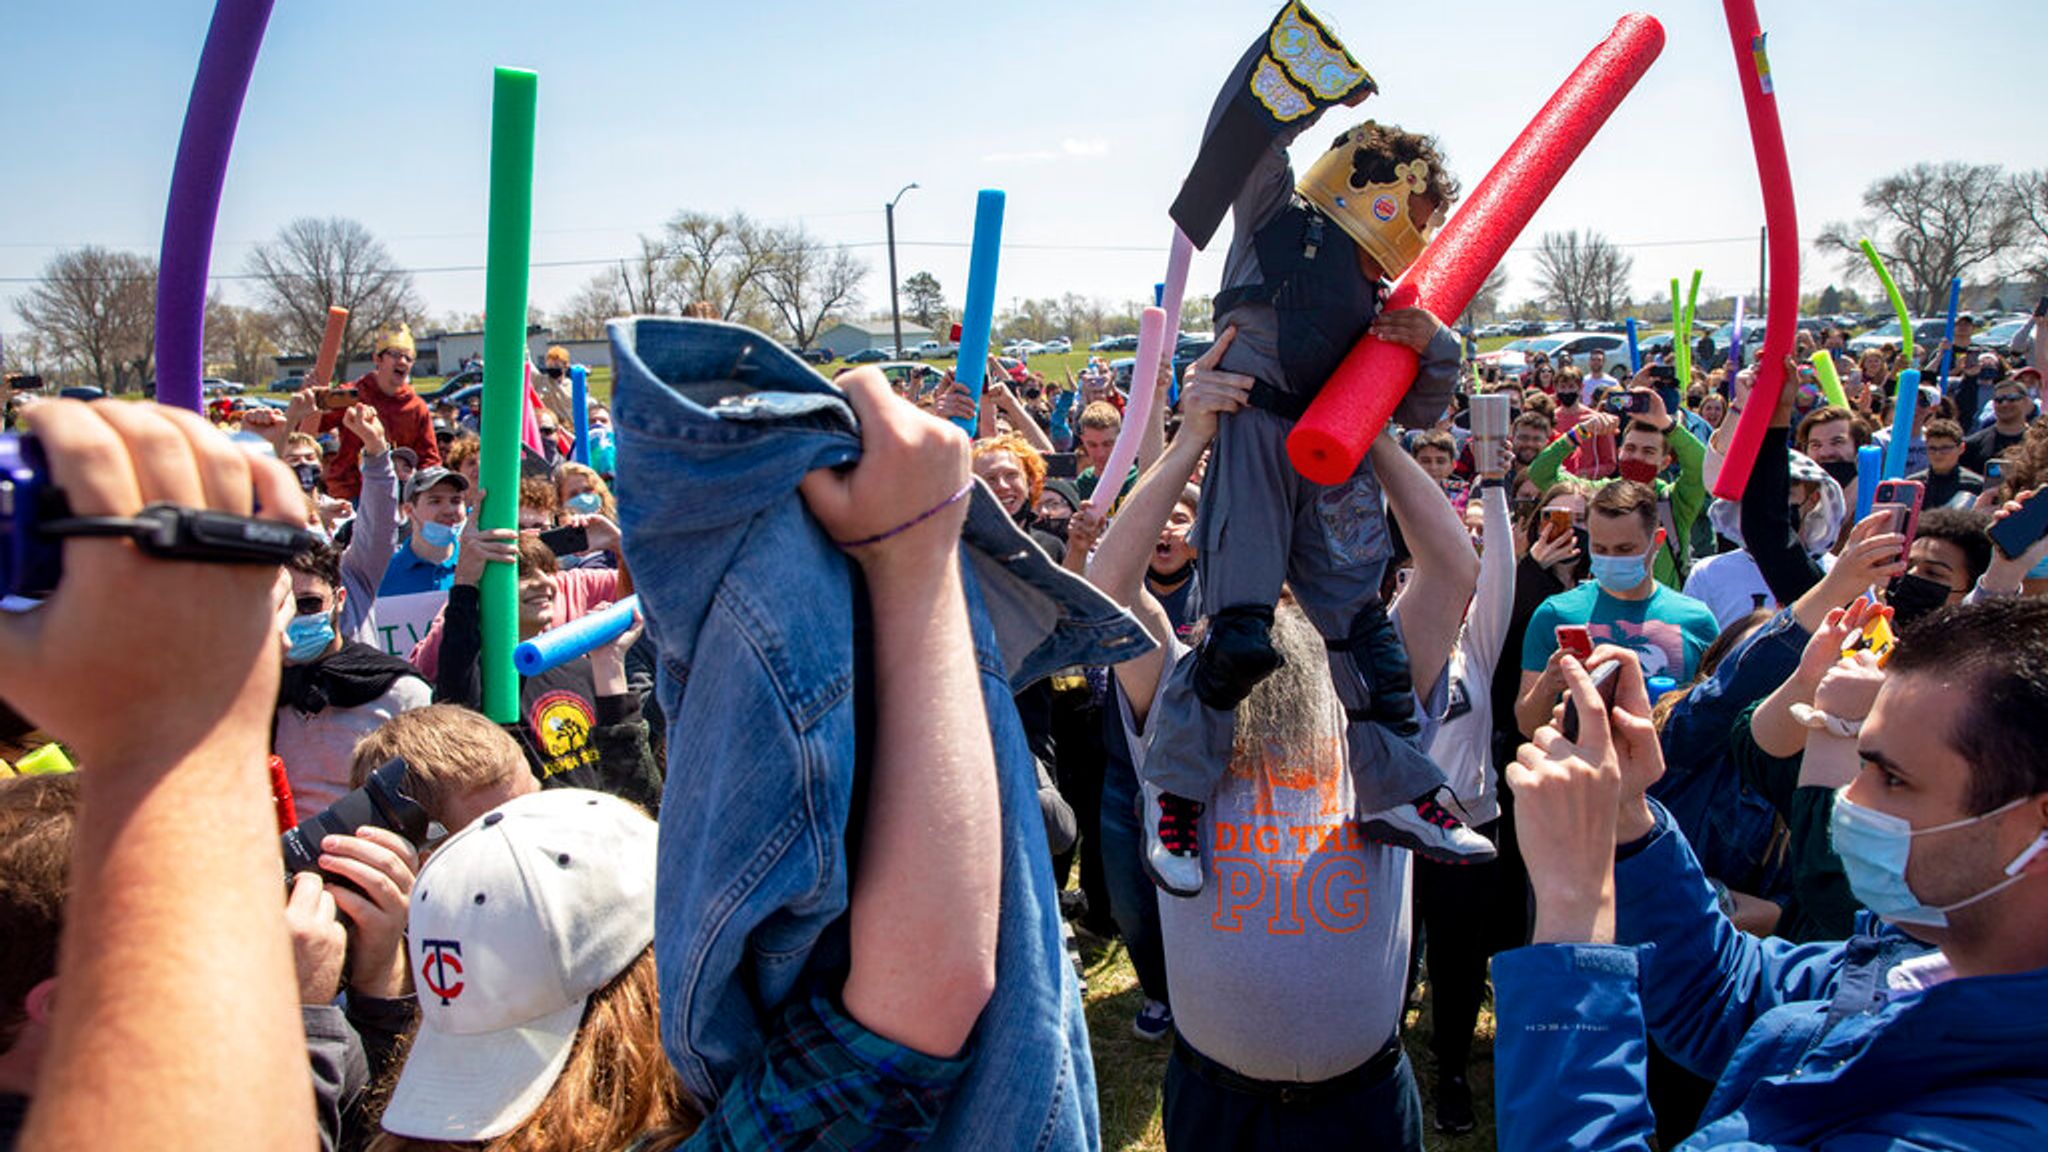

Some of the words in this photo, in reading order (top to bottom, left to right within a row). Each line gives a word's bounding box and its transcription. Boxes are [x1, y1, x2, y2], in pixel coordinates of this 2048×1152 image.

[1213, 822, 1280, 854] DIG
[1289, 823, 1363, 855] THE
[1212, 856, 1369, 935] PIG
[422, 938, 464, 1006] TC
